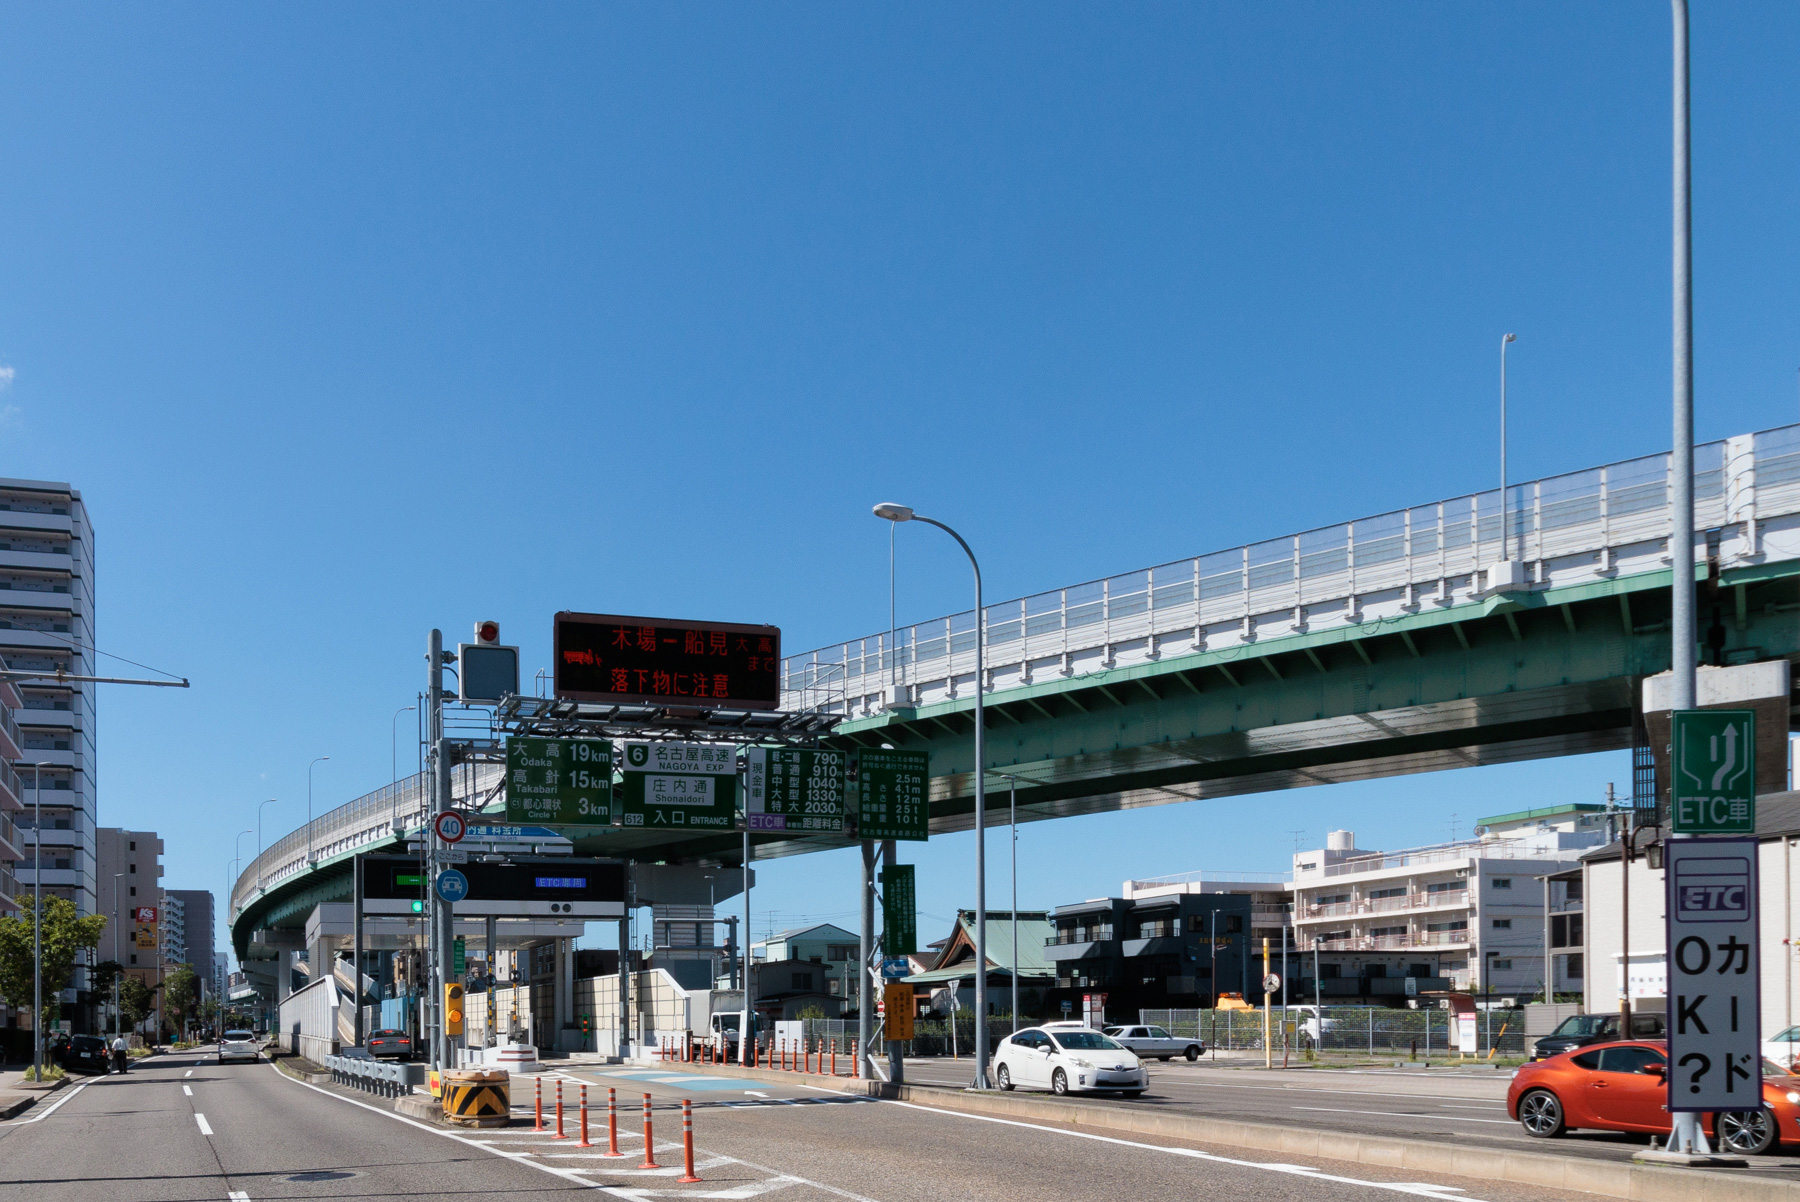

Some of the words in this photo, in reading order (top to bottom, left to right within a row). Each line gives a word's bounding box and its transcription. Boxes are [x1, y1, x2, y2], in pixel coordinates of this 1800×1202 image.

[735, 636, 773, 652] 大高
[748, 656, 775, 672] まで
[611, 668, 729, 698] 落下物に注意
[513, 741, 560, 758] 大高
[632, 747, 644, 762] 6
[654, 746, 729, 762] 名古屋高速
[520, 757, 552, 767] Odaka
[659, 762, 699, 771] NAGOYA
[706, 763, 724, 772] EXP
[772, 763, 800, 775] 普通
[513, 768, 560, 784] 高針
[752, 762, 763, 798] 現金車
[772, 776, 800, 788] 中型
[515, 784, 558, 793] Takabari
[652, 778, 707, 794] 庄内通
[862, 782, 887, 792] 高さ
[655, 793, 705, 803] Shonaidori
[771, 788, 800, 800] 大型
[523, 798, 561, 810] 都心環状
[771, 800, 799, 812] 特大
[1678, 796, 1749, 824] ETC車
[528, 811, 551, 819] Circle
[625, 814, 643, 824] 612
[653, 810, 685, 824] 入口
[690, 816, 728, 825] ENTRANCE
[749, 815, 784, 828] ETC車
[442, 820, 459, 835] 40
[438, 852, 464, 861] ここから
[1684, 886, 1744, 909] ETC
